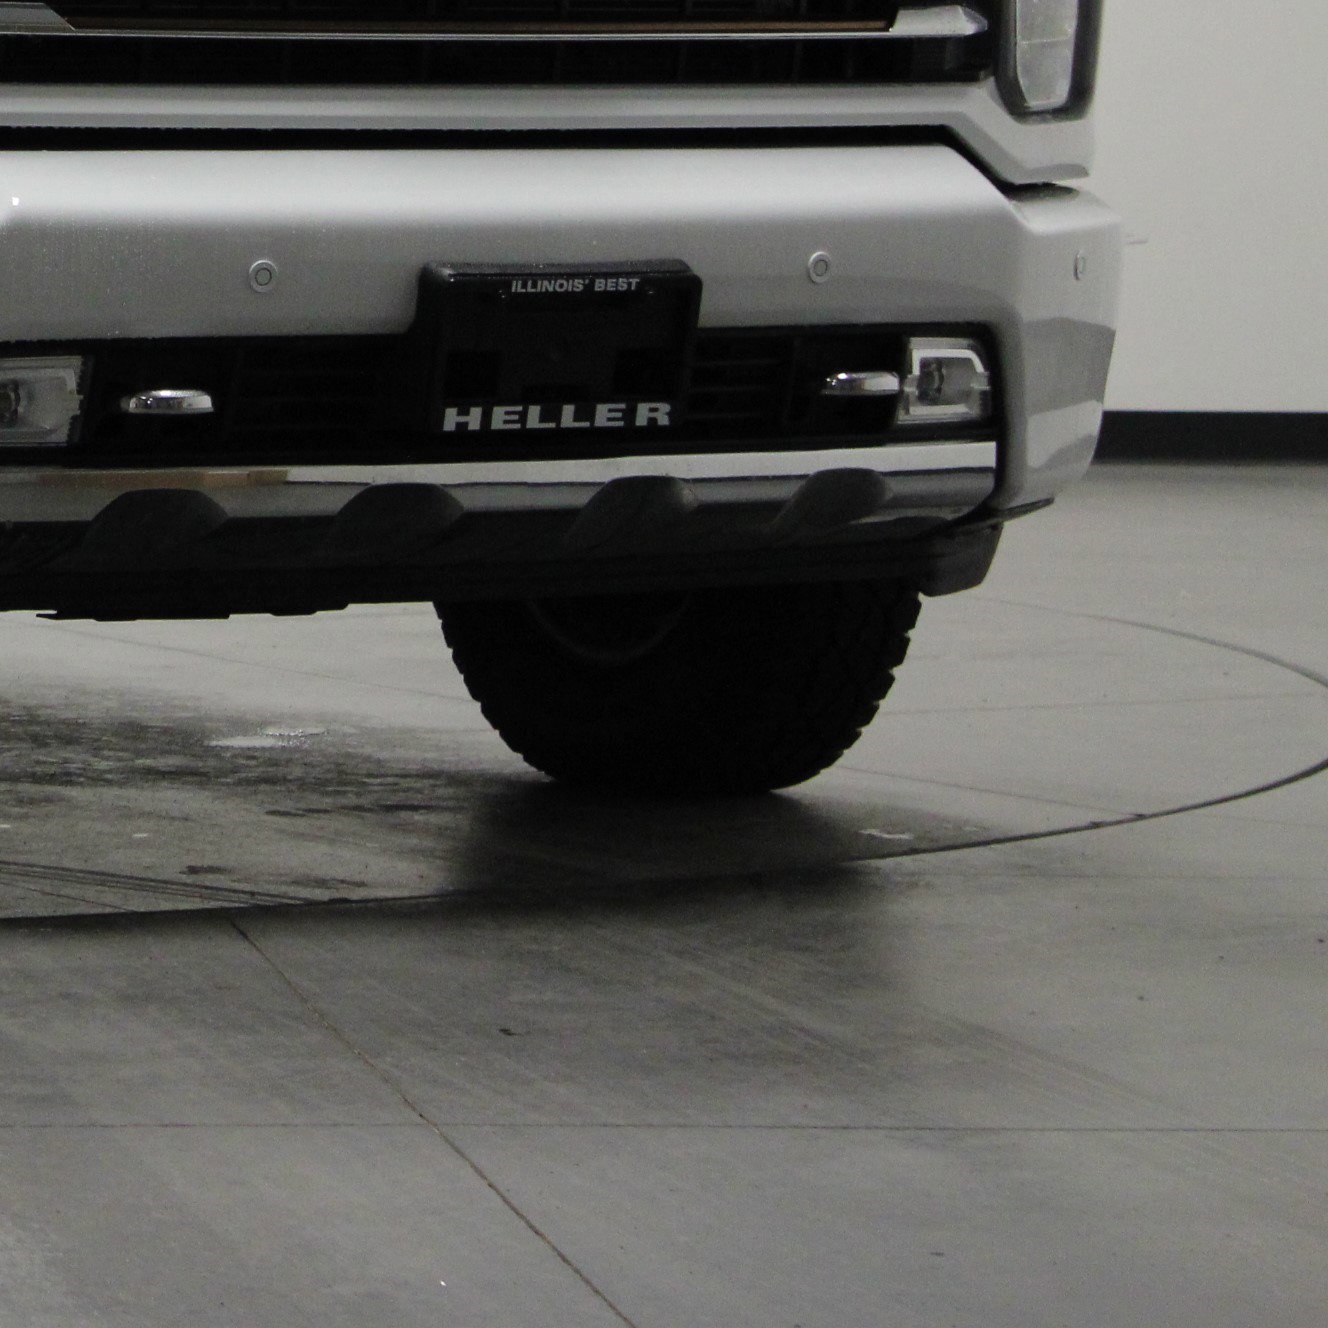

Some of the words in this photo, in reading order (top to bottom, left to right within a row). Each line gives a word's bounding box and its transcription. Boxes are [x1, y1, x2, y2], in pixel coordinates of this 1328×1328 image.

[511, 278, 590, 293] ILLINOIS'
[594, 277, 640, 291] BEST
[443, 402, 672, 432] HELLER
